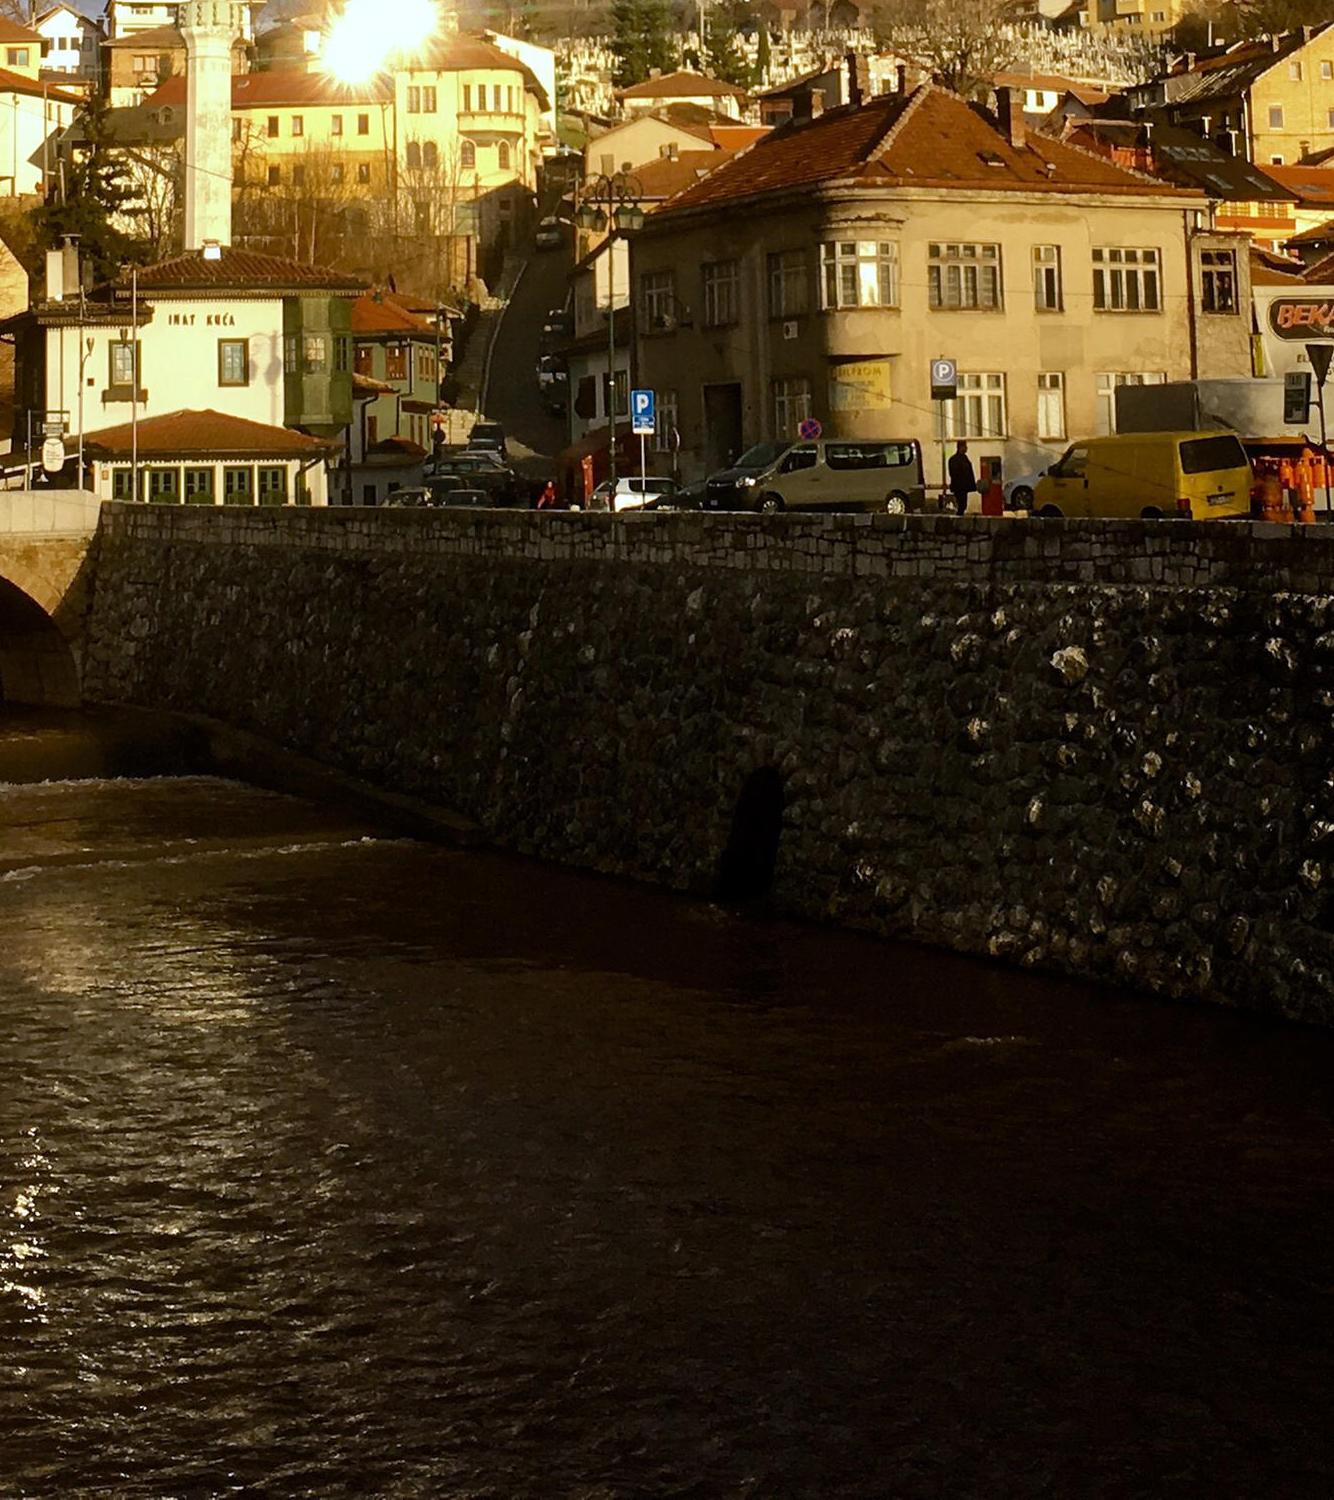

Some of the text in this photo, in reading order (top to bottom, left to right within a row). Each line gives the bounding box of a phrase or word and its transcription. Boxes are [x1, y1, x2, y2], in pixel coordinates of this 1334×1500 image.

[168, 312, 235, 326] INAT KUĆA
[938, 363, 950, 378] P
[636, 393, 650, 414] P
